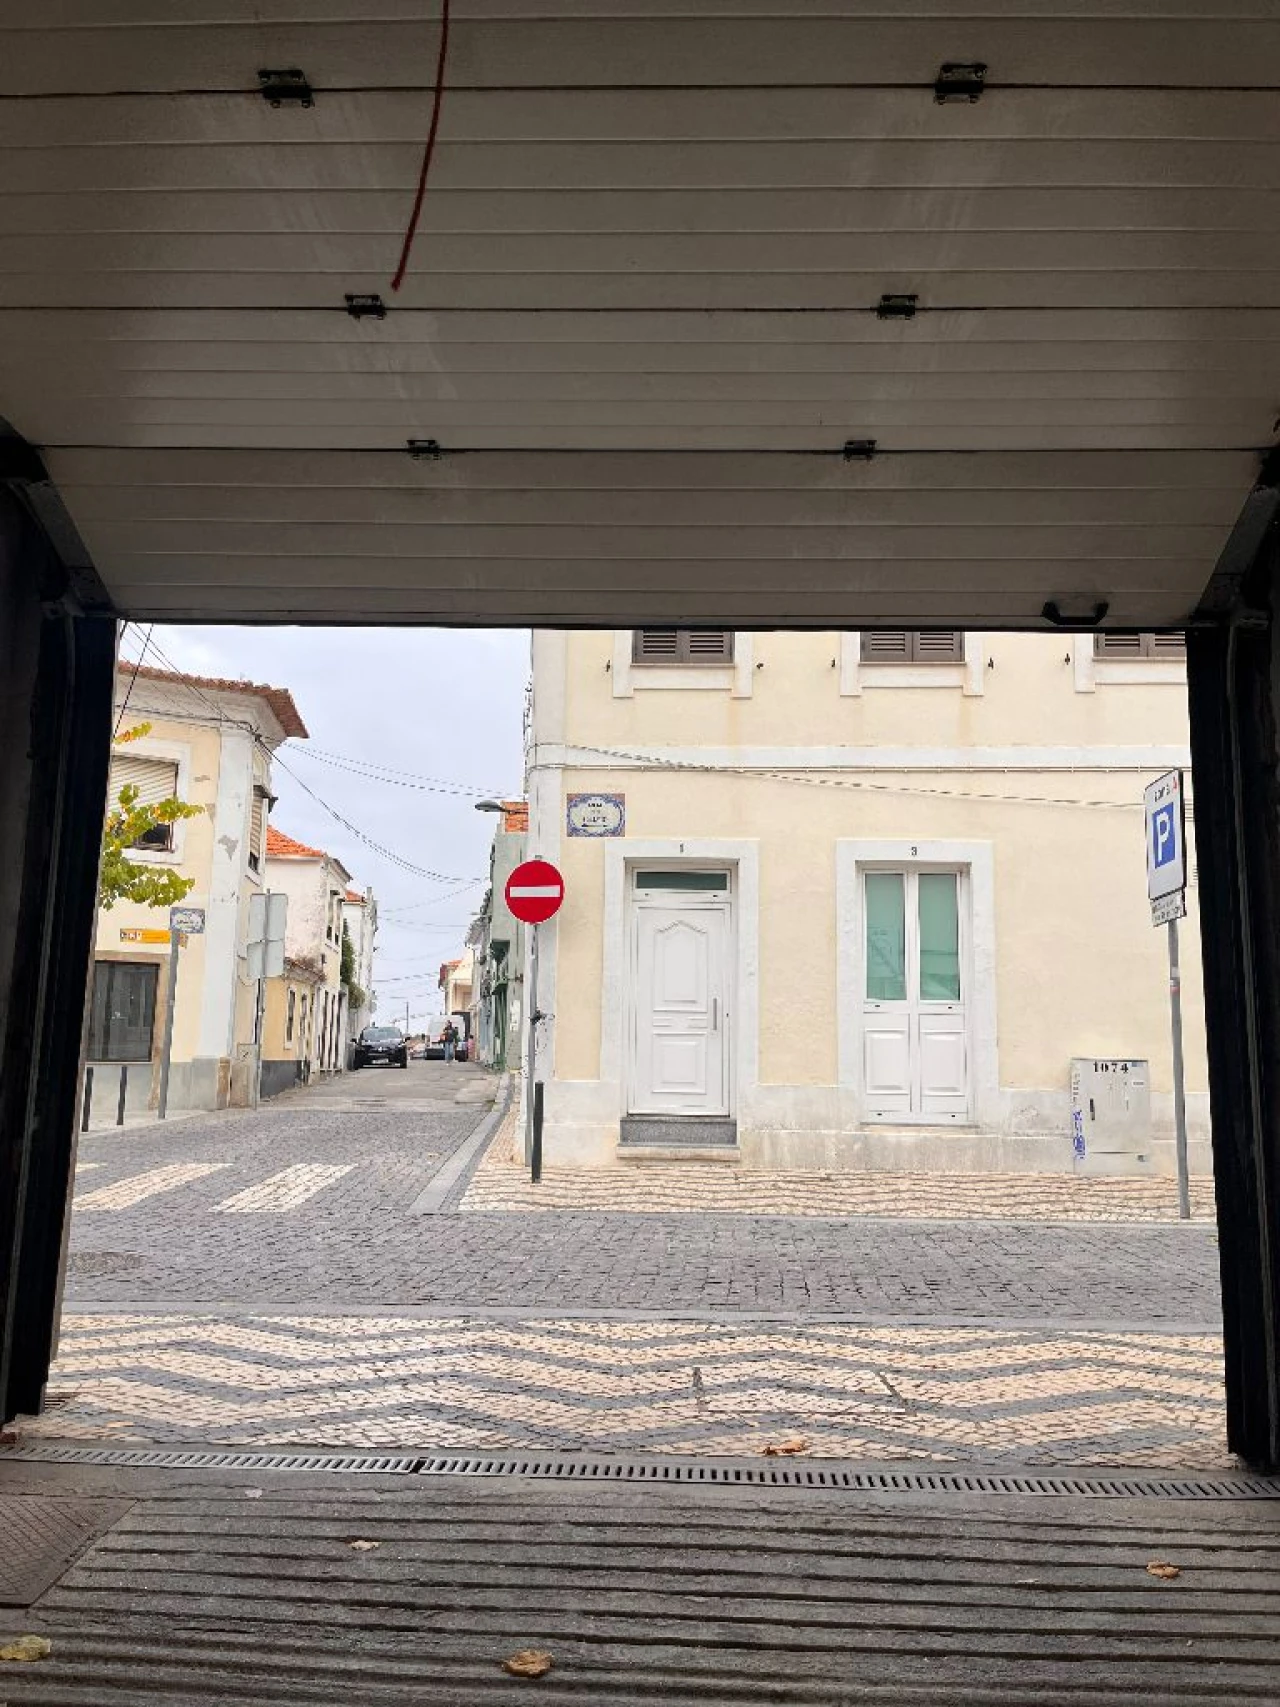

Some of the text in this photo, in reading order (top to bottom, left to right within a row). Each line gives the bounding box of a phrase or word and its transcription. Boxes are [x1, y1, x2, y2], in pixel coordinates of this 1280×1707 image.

[1156, 812, 1170, 863] P
[911, 846, 918, 856] 3
[1093, 1061, 1129, 1074] 1074
